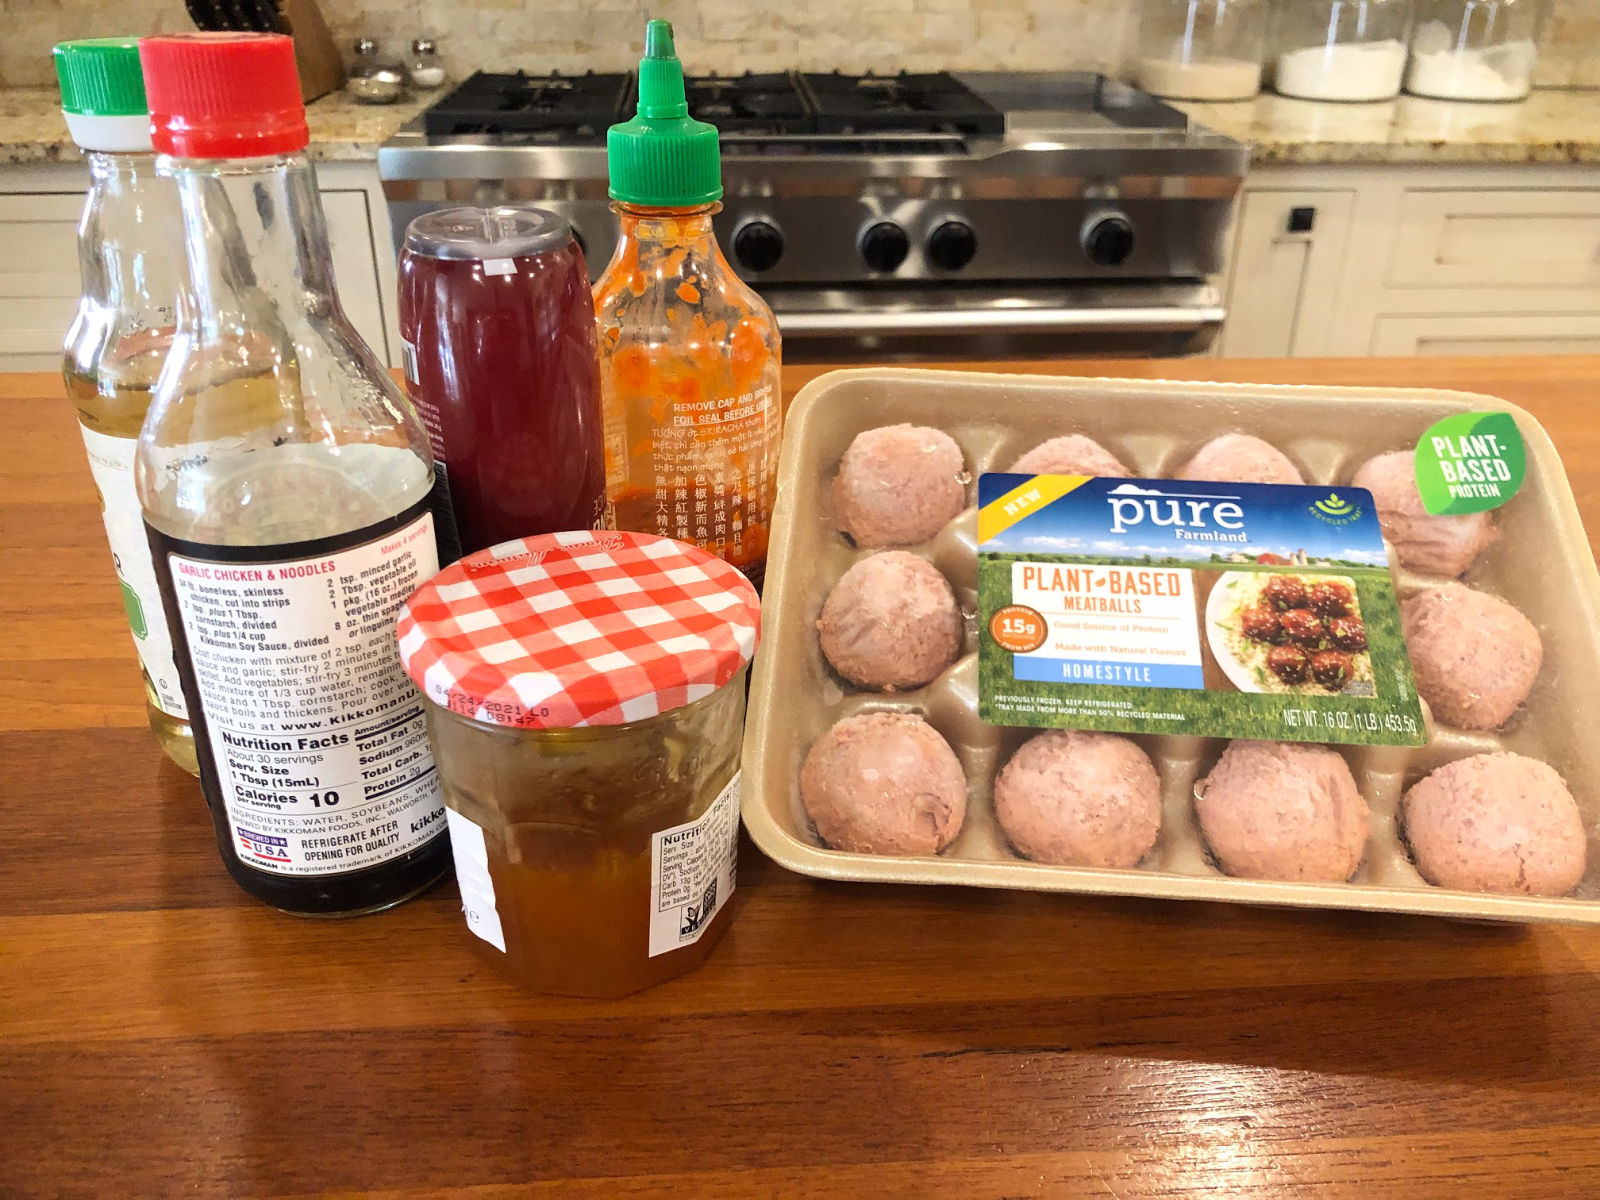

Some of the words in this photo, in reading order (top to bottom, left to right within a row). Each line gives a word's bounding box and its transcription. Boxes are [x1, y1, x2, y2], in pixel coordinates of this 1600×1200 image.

[674, 401, 715, 412] REMOVE
[718, 398, 735, 409] CAP
[738, 393, 753, 404] AND
[674, 416, 695, 425] FOIL
[698, 414, 721, 424] SEAL
[724, 406, 755, 420] BEFORE
[1430, 434, 1507, 458] PLANT-
[1439, 458, 1511, 482] BASED
[1448, 484, 1501, 499] PROTEIN
[1003, 489, 1042, 516] NEW
[1107, 497, 1245, 533] pure
[1175, 529, 1248, 543] Farmland
[179, 563, 211, 579] GARLIC
[214, 570, 263, 581] CHICKEN
[268, 570, 275, 580] &
[280, 561, 336, 579] NOODLES
[360, 561, 390, 579] minced
[393, 551, 412, 567] garlic
[370, 566, 407, 587] vegetable
[398, 570, 418, 587] frozen
[1023, 567, 1094, 592] PLANT
[1109, 570, 1181, 597] BASED
[244, 588, 284, 597] skinless
[242, 600, 259, 608] into
[262, 598, 291, 608] strips
[346, 596, 388, 617] vegetable
[1064, 596, 1142, 614] MEATBALLS
[209, 608, 226, 617] plus
[362, 612, 379, 624] thin
[242, 621, 277, 630] divided
[1002, 618, 1035, 635] 15g
[1054, 621, 1080, 630] Good
[1082, 622, 1117, 632] Source
[1120, 623, 1130, 632] of
[1132, 623, 1169, 633] Protein
[214, 630, 231, 638] plus
[250, 633, 266, 641] cup
[239, 642, 255, 653] Soy
[294, 636, 329, 649] divided
[1055, 643, 1082, 652] Made
[1085, 644, 1108, 654] with
[1110, 645, 1147, 655] Natural
[1150, 647, 1186, 657] Flavors
[250, 656, 272, 666] with
[276, 654, 317, 665] mixture
[321, 651, 332, 660] of
[280, 664, 319, 677] stir-fry
[336, 650, 378, 668] minutes
[307, 672, 341, 685] stir-fry
[354, 655, 392, 673] minutes
[1063, 663, 1152, 682] HOMESTYLE
[296, 688, 316, 697] cup
[994, 695, 1034, 703] PREVIOUSLY
[1066, 698, 1082, 706] KEEP
[232, 706, 256, 718] boils
[260, 709, 280, 719] and
[342, 696, 367, 710] Pour
[372, 686, 394, 701] over
[1016, 705, 1034, 713] MADE
[1079, 708, 1097, 716] THAN
[1099, 709, 1114, 717] 50%
[1116, 710, 1150, 719] RECYCLED
[1152, 712, 1186, 721] MATERIAL
[240, 722, 255, 730] us
[262, 723, 275, 731] at
[1284, 709, 1300, 727] NET
[1303, 710, 1321, 727] WT.
[1323, 711, 1335, 728] 16
[1385, 714, 1419, 736] 453.5g
[222, 732, 292, 751] Nutrition
[298, 734, 349, 751] Facts
[356, 736, 388, 752] Total
[391, 727, 408, 740] Fat
[228, 748, 255, 762] About
[257, 754, 271, 764] 30
[274, 754, 324, 765] servings
[360, 745, 403, 765] Sodium
[230, 759, 257, 773] Serv.
[261, 766, 289, 775] Size
[362, 764, 392, 780] Total
[395, 752, 423, 768] Carb.
[240, 773, 268, 787] Tbsp
[272, 777, 319, 788] (15mL)
[364, 774, 406, 794] Protein
[410, 767, 421, 776] 2g
[236, 786, 298, 803] Calories
[310, 791, 340, 808] 10
[252, 800, 282, 810] serving
[275, 827, 326, 835] KIKKOMAN
[302, 830, 367, 849] REFRIGERATE
[370, 820, 398, 838] AFTER
[253, 843, 288, 857] USA
[304, 848, 344, 861] OPENING
[346, 844, 363, 857] FOR
[366, 832, 400, 852] QUALITY
[662, 888, 681, 899] Protein
